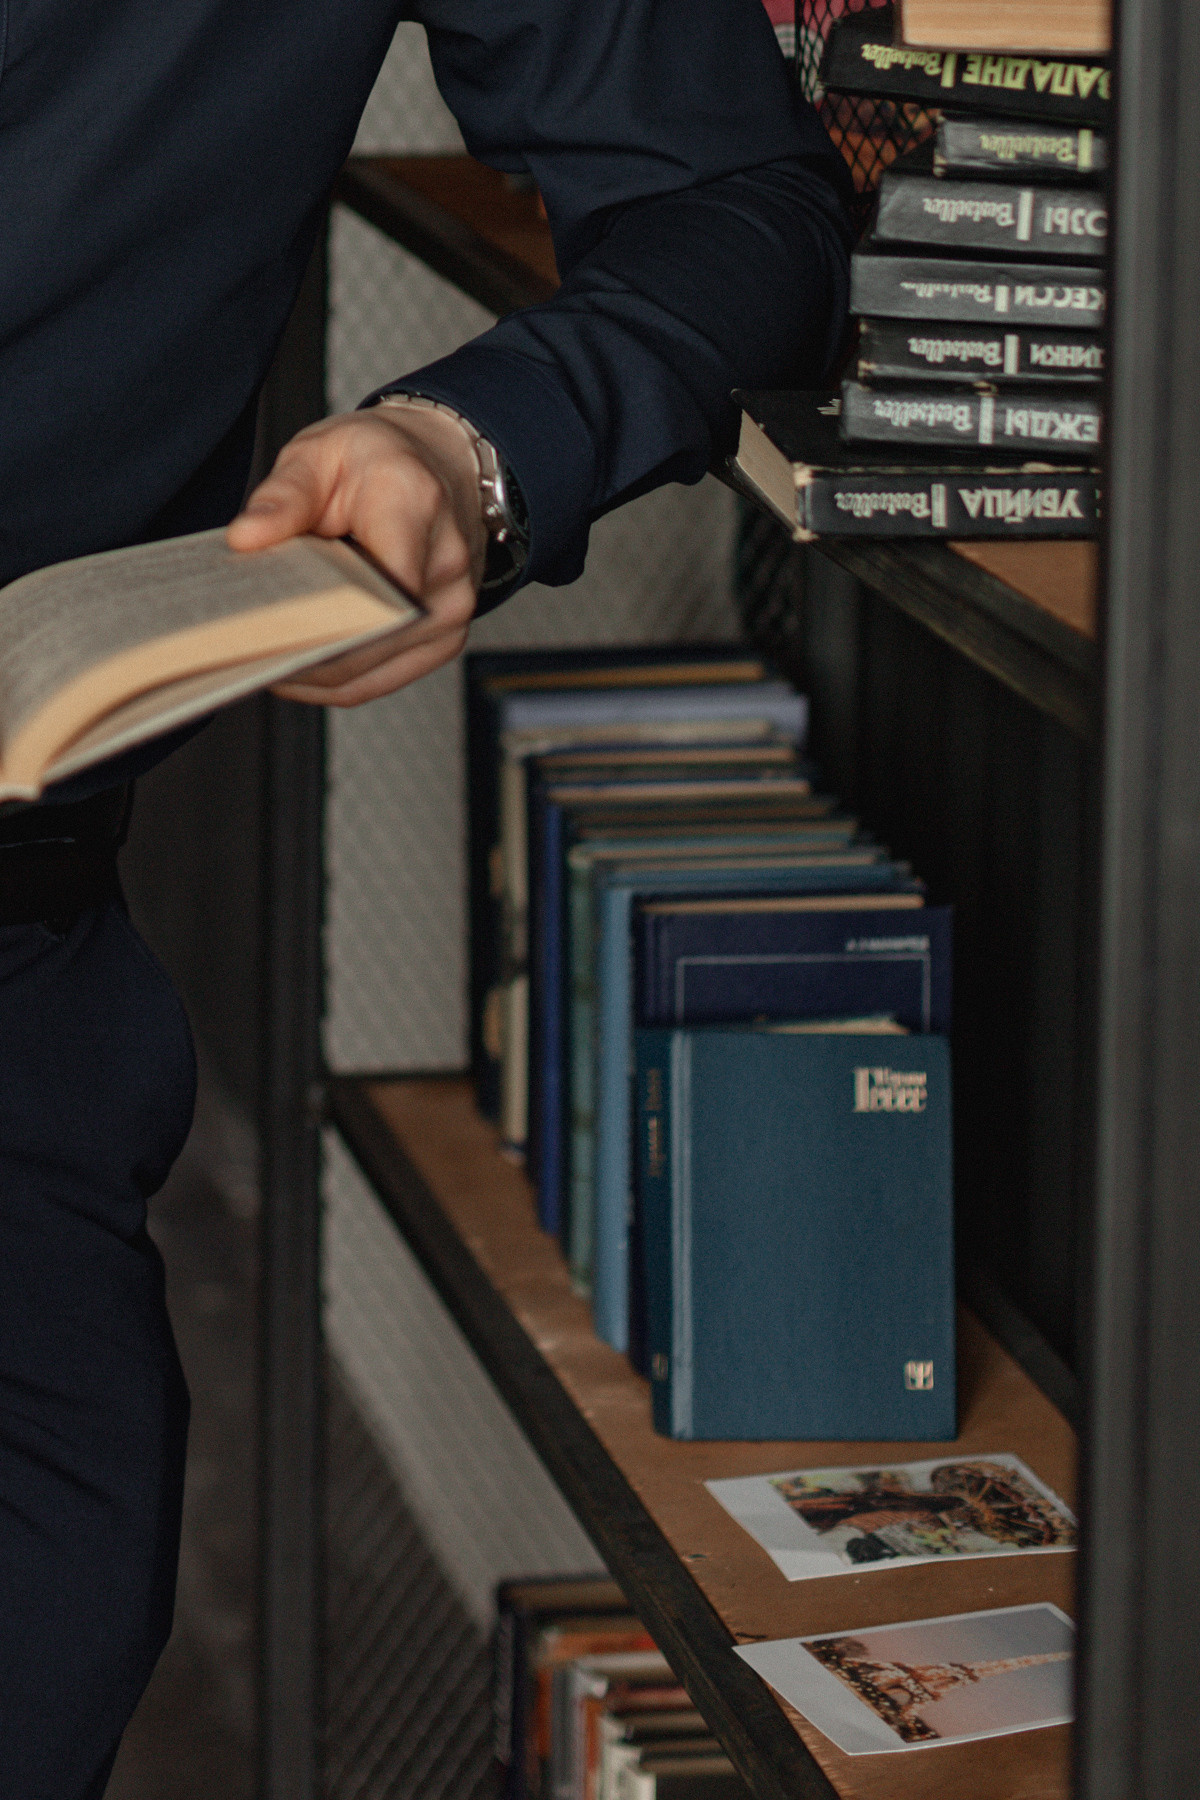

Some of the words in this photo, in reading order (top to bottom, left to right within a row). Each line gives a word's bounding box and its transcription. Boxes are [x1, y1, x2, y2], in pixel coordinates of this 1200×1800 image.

[978, 133, 1077, 162] Bestseller
[921, 196, 1016, 229] Bestseller
[907, 336, 1004, 367] Bestseller
[871, 399, 974, 434] Bestseller
[833, 491, 932, 519] Bestseller
[958, 486, 1085, 525] УБИЙЦА
